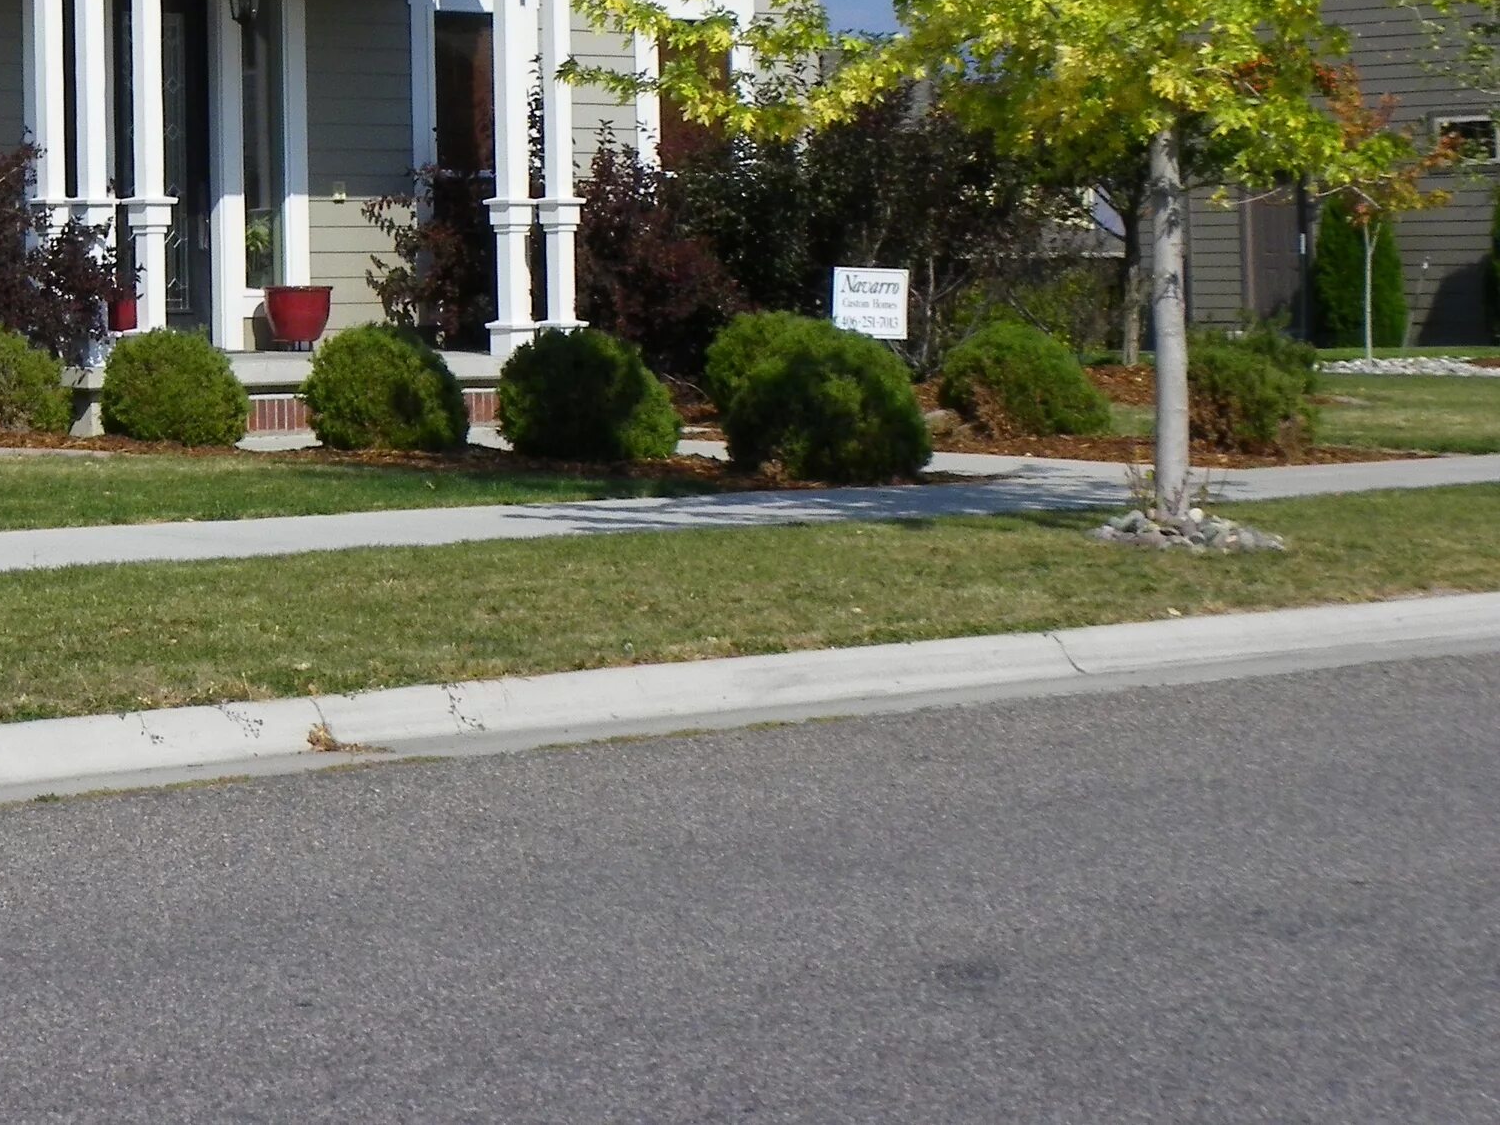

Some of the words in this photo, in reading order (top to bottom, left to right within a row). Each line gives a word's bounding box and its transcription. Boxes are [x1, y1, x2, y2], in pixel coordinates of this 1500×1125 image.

[840, 274, 900, 295] Navarro
[842, 297, 870, 308] Custom
[873, 299, 898, 309] Homes
